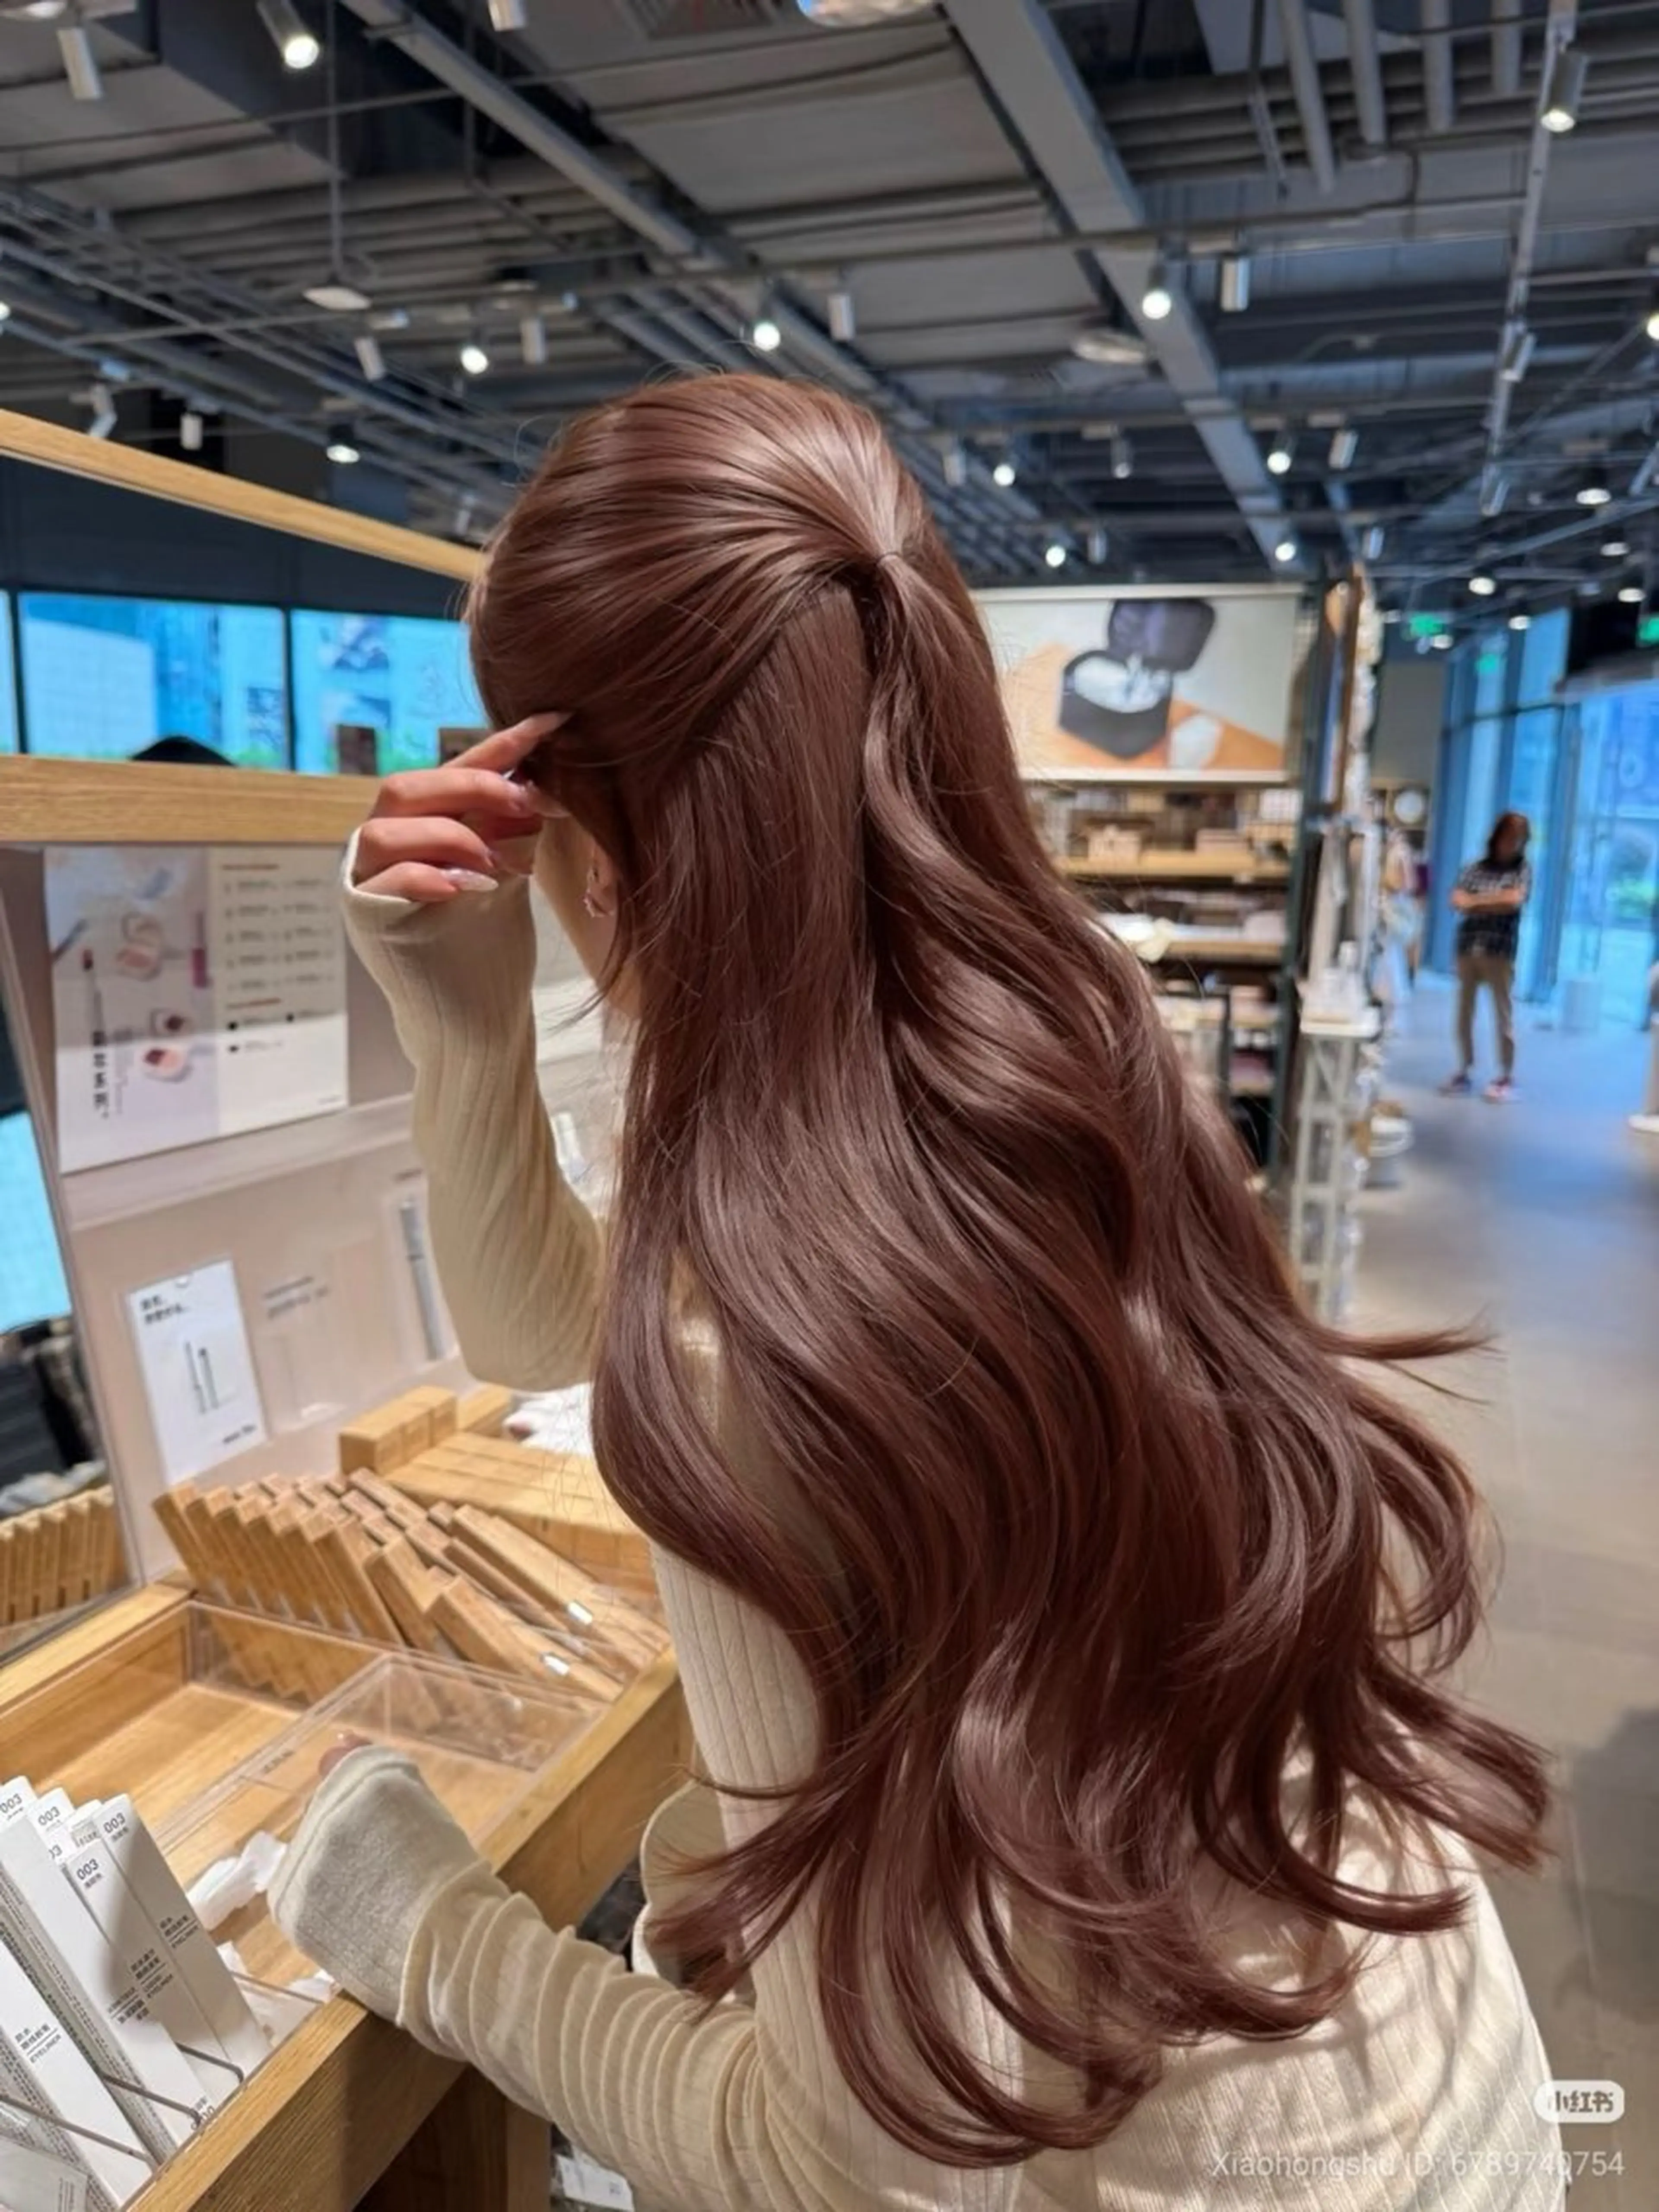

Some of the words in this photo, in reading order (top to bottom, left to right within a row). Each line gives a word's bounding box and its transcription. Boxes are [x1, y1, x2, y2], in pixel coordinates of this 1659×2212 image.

[0, 1793, 22, 1814] 003
[38, 1806, 60, 1826] 003
[103, 1812, 126, 1834] 003
[76, 1858, 99, 1880] 003
